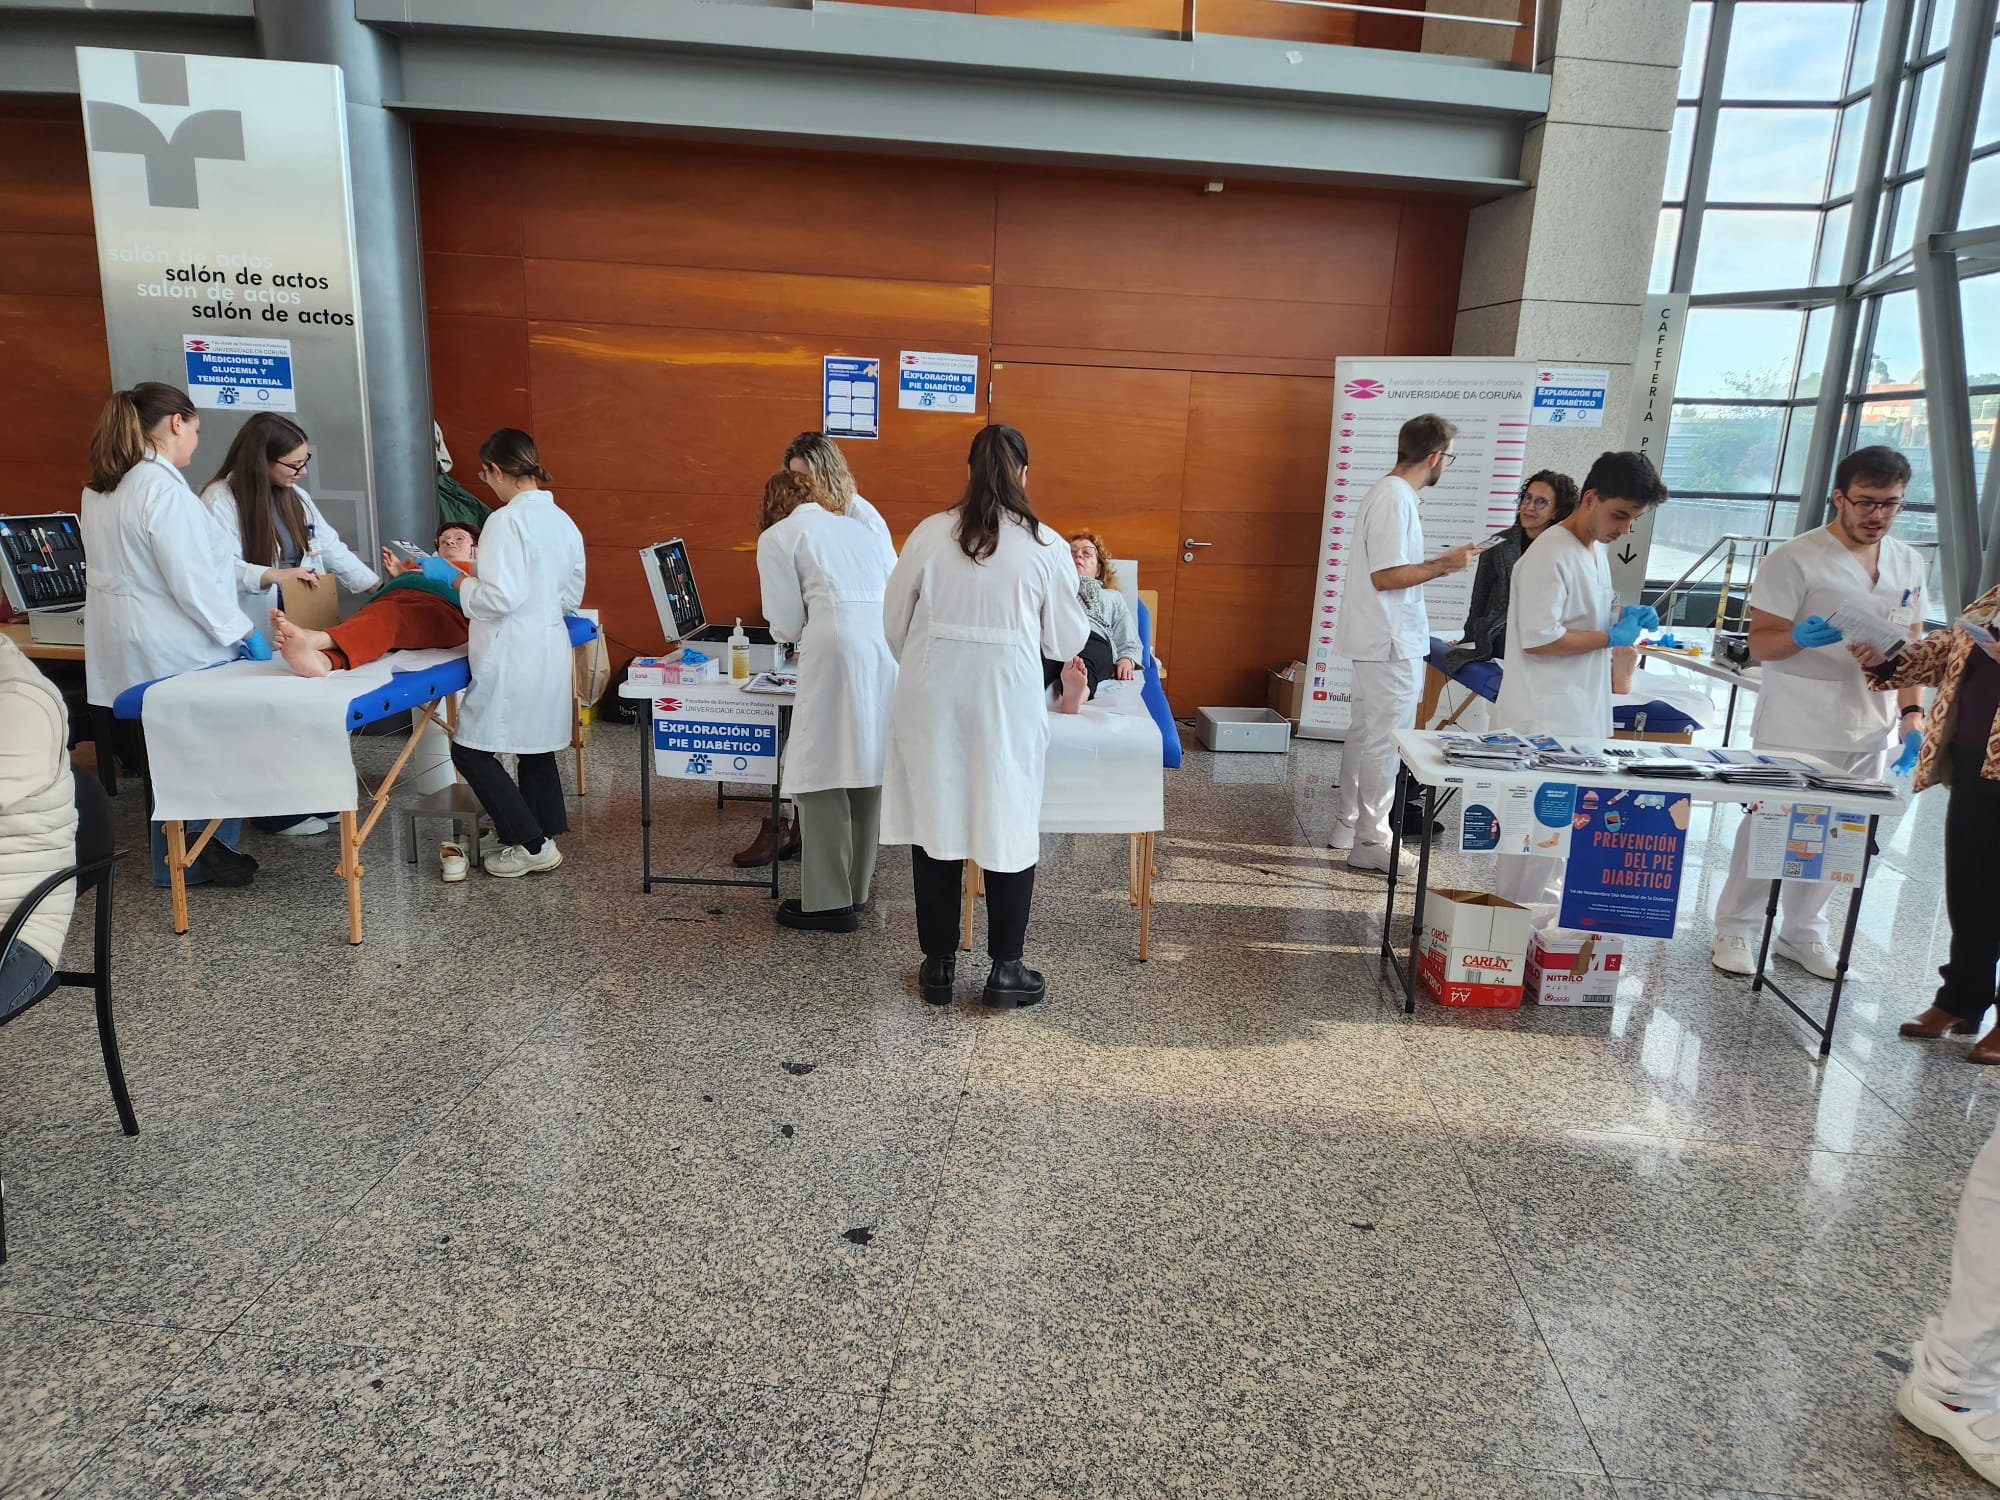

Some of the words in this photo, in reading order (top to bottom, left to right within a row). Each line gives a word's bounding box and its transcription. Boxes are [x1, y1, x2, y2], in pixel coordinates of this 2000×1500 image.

[165, 264, 225, 283] salón
[235, 267, 262, 285] de
[273, 272, 329, 289] actos
[207, 282, 234, 301] de
[244, 287, 300, 305] actos
[192, 300, 252, 320] salón
[261, 304, 288, 322] de
[298, 309, 354, 326] actos
[202, 354, 259, 365] MEDICIONES
[261, 358, 274, 366] DE
[1643, 308, 1671, 422] CAFETERIA
[211, 366, 258, 375] GLUCEMIA
[903, 371, 960, 382] EXPLORACIÓN
[197, 375, 237, 384] TENSIÓN
[239, 377, 283, 386] ARTERIAL
[924, 383, 966, 392] DIABÉTICO
[1538, 388, 1591, 397] EXPLORACIÓN
[1388, 390, 1461, 399] UNIVERSIDADE
[1462, 391, 1478, 400] DA
[1479, 389, 1523, 400] CORUÑA
[1556, 398, 1596, 407] DIABÉTICO
[685, 706, 735, 714] UNIVERSIDADE
[658, 721, 750, 736] EXPLORACIÓN
[754, 728, 771, 738] DE
[668, 738, 689, 748] PIE
[693, 740, 761, 752] DIABÉTICO
[1592, 831, 1677, 852] PREVENCIÓN
[1624, 852, 1648, 869] DEL
[1652, 854, 1675, 870] PIE
[1601, 868, 1672, 889] DIABÉTICO
[1451, 991, 1471, 1003] A4
